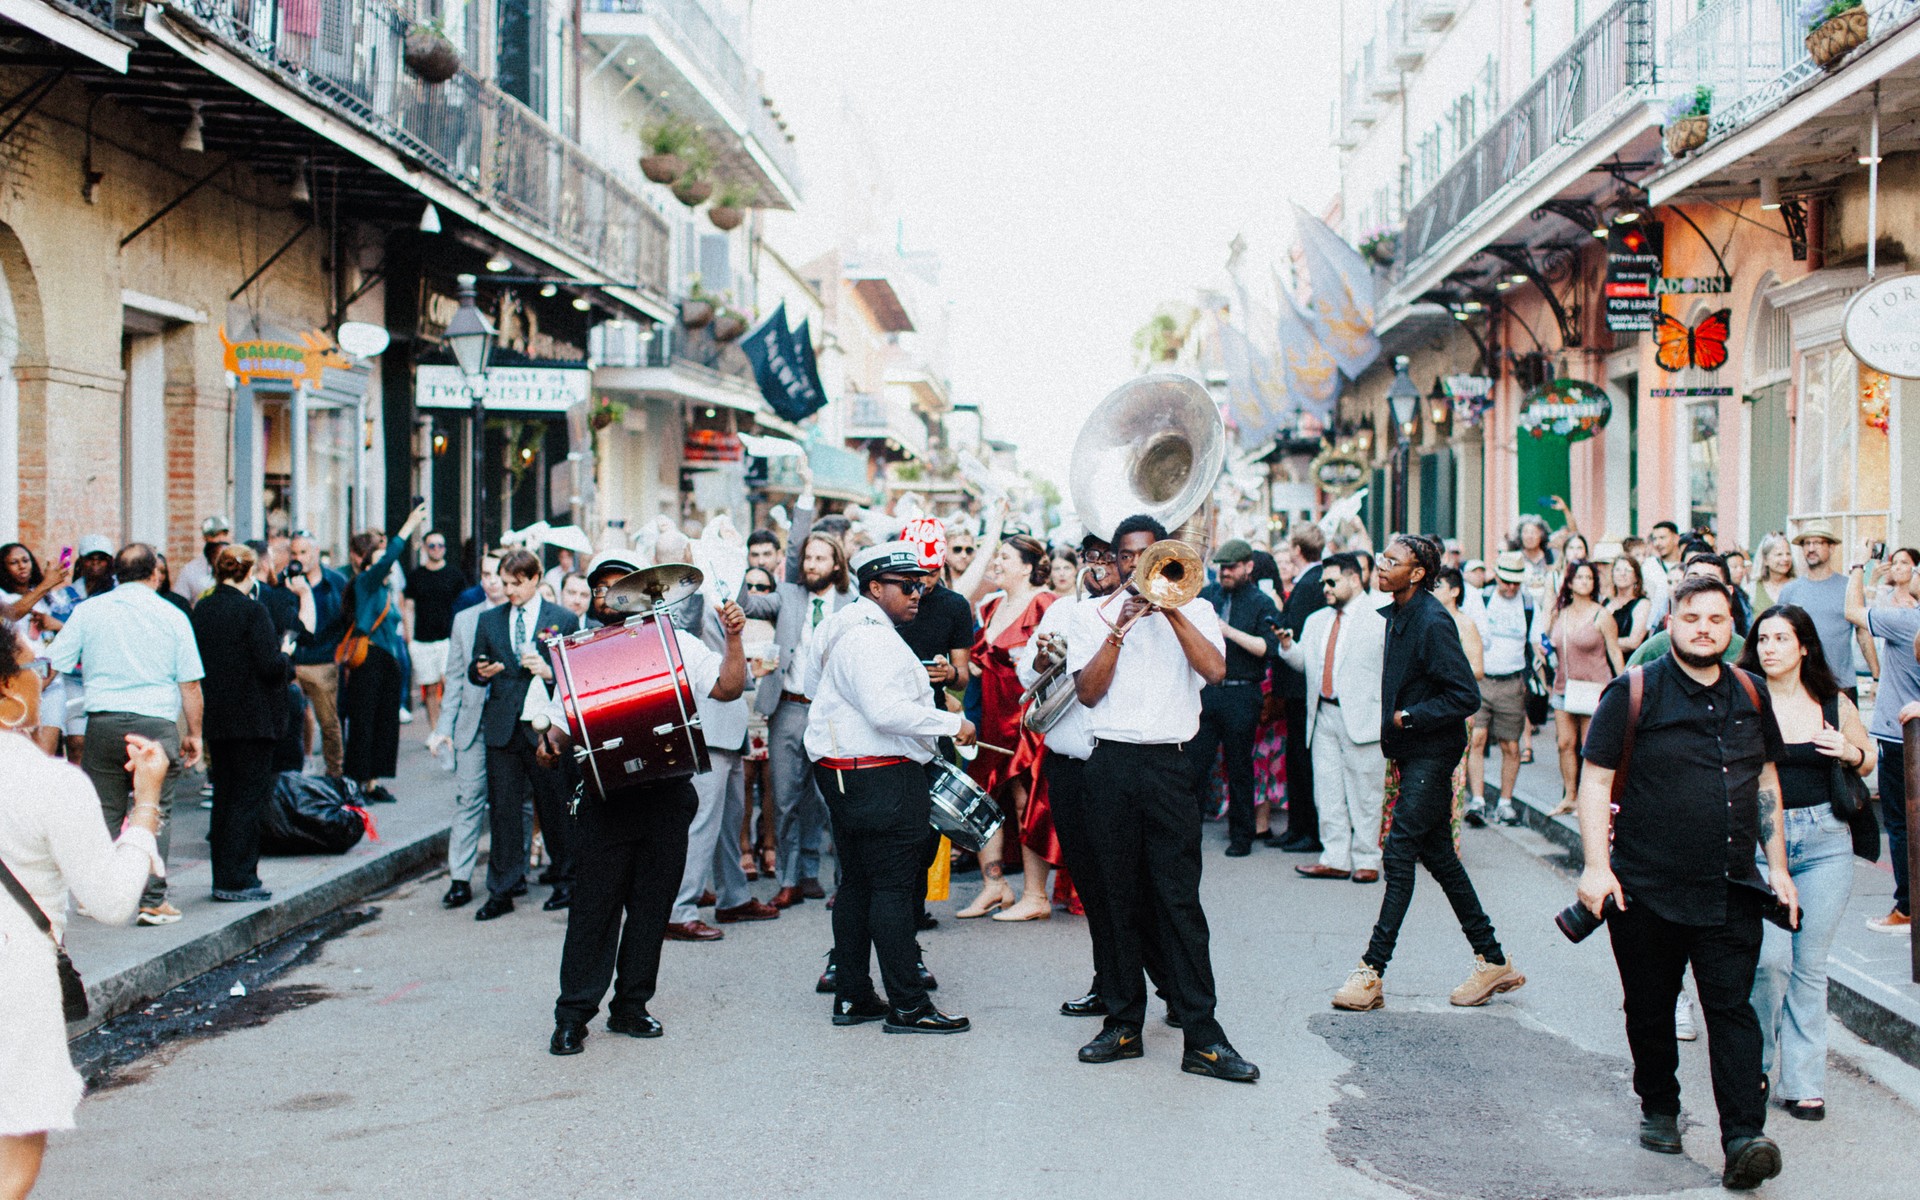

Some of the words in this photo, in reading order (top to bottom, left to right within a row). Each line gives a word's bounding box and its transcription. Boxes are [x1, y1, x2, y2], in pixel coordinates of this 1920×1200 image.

[1654, 278, 1725, 294] ADORN
[1609, 299, 1629, 310] FOR
[235, 344, 304, 362] GALLERY
[1870, 343, 1900, 354] NEW
[427, 384, 474, 398] TWO
[484, 386, 578, 402] SISTERS
